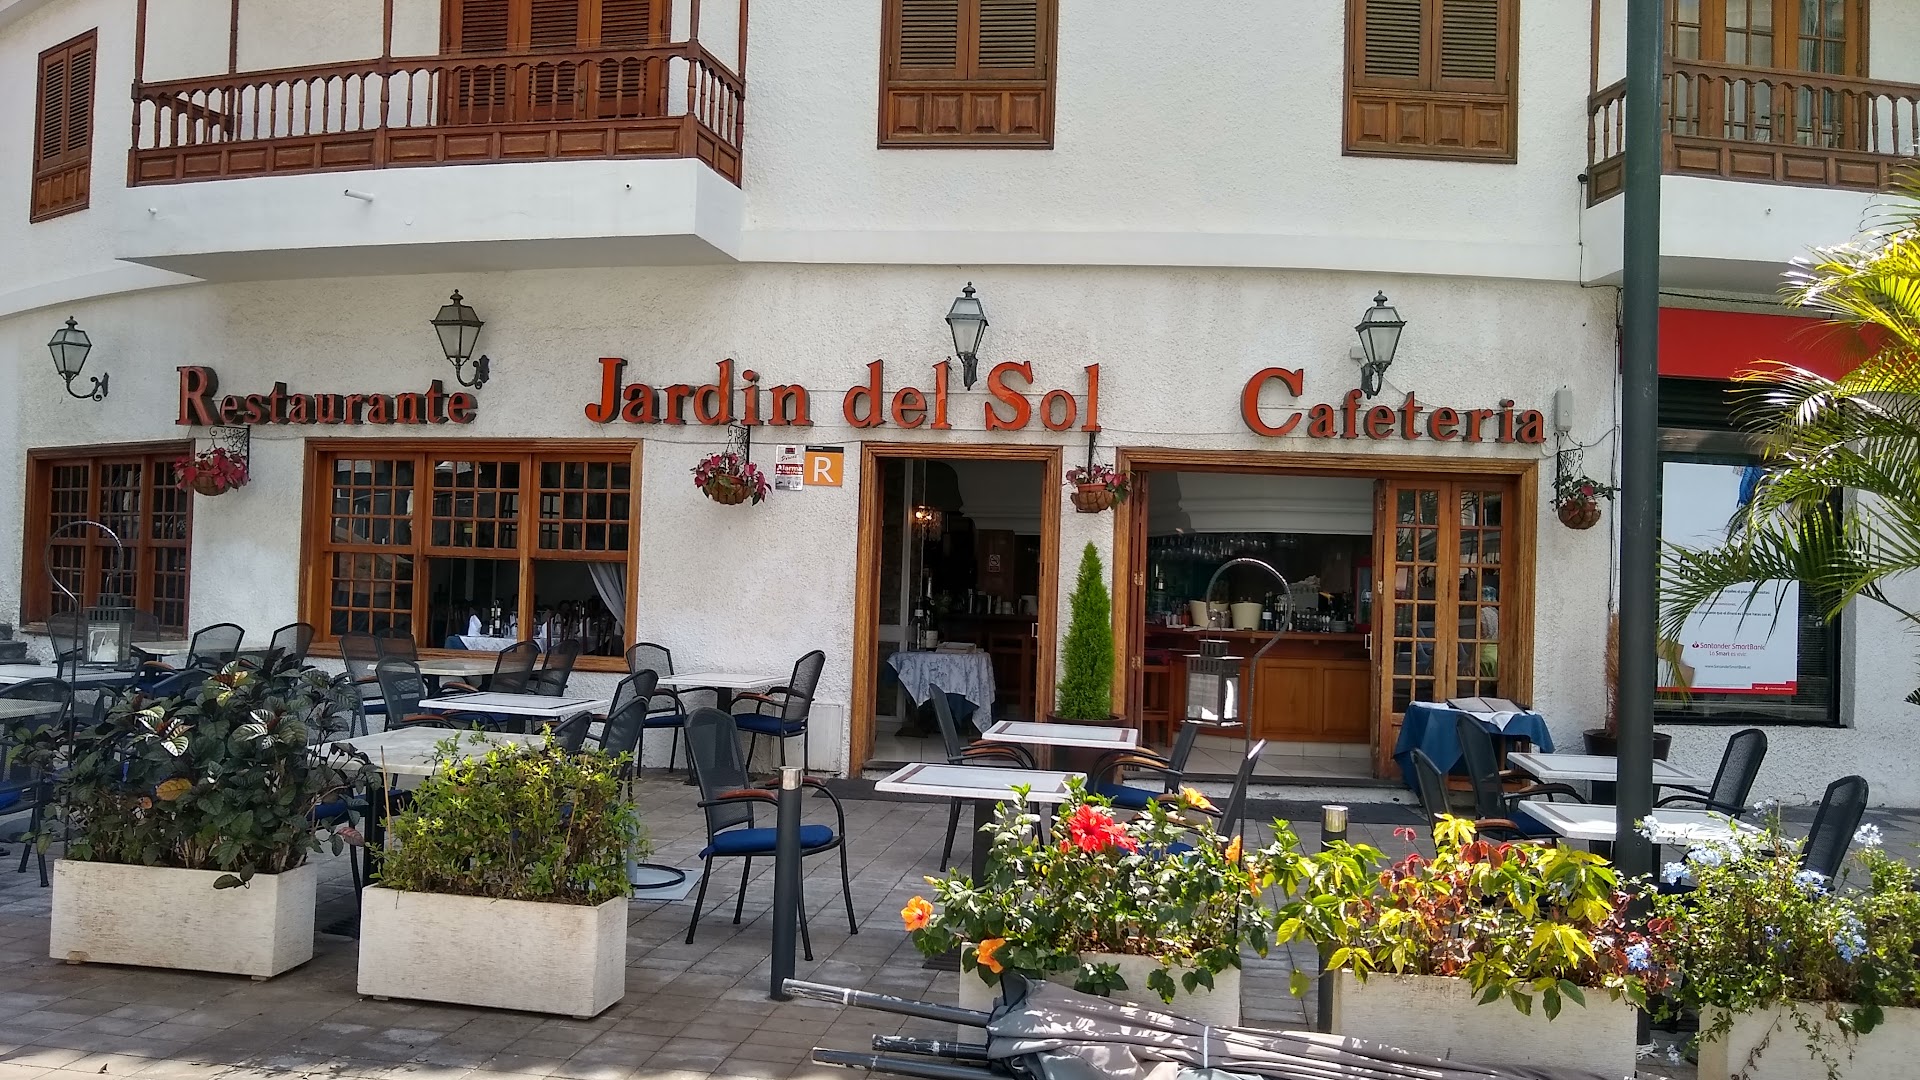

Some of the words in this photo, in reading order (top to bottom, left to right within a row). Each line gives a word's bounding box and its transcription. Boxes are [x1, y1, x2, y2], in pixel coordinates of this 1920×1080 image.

[176, 366, 479, 425] Restaurante
[585, 357, 814, 427] Jardin
[842, 358, 952, 430] del
[984, 361, 1101, 433] Sol
[1240, 367, 1547, 444] Cafeteria
[813, 456, 834, 483] R
[1700, 642, 1730, 650] Santander
